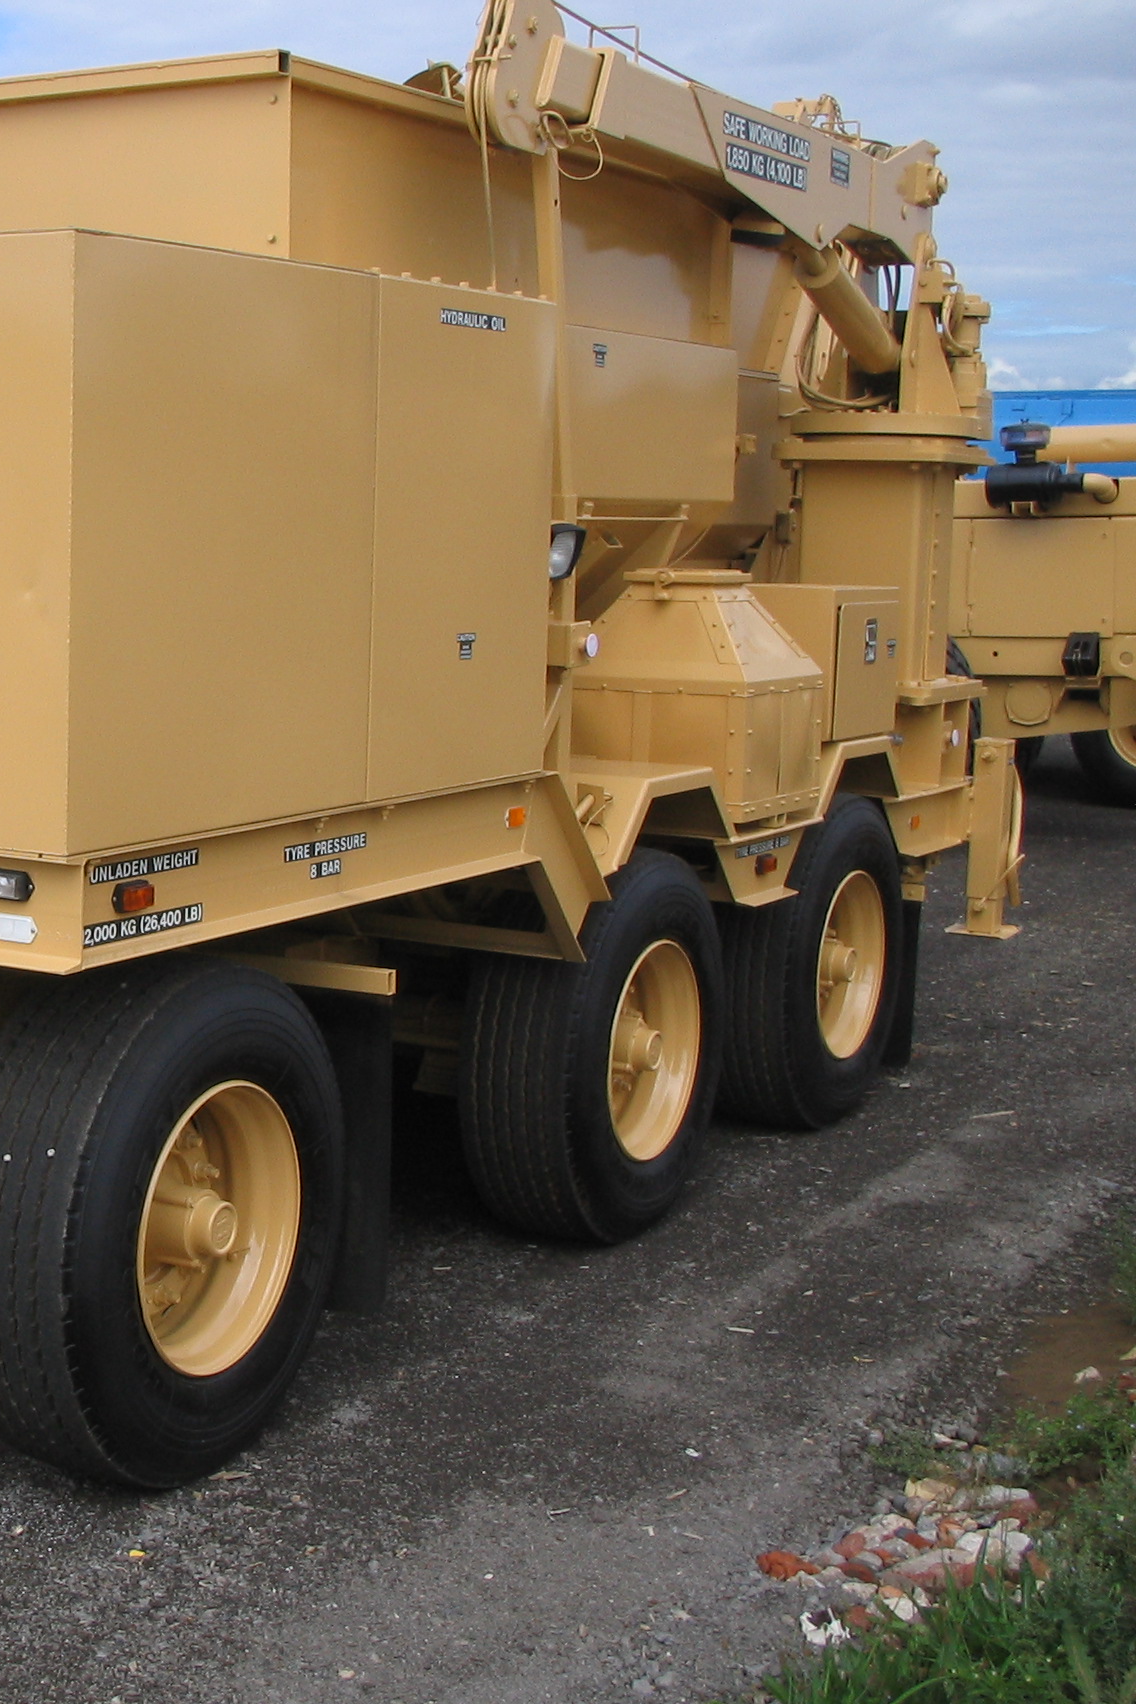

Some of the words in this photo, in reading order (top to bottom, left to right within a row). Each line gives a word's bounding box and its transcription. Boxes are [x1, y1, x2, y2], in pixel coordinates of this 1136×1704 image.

[724, 112, 746, 139] SAFE
[748, 121, 788, 153] WORKING
[789, 136, 811, 161] LOAD
[726, 145, 750, 171] 1,850
[751, 153, 765, 176] KG
[793, 166, 808, 191] LB)
[440, 309, 489, 329] HYDRAULIC
[491, 316, 506, 331] OIL
[284, 844, 310, 862] TYRE
[314, 833, 366, 856] PRESSURE
[90, 859, 148, 883] UNLADEN
[153, 849, 198, 872] WEIGHT
[310, 864, 317, 878] 8
[321, 859, 341, 876] BAR
[120, 919, 137, 937] KG
[140, 909, 182, 933] (26,400
[184, 903, 202, 921] LB)
